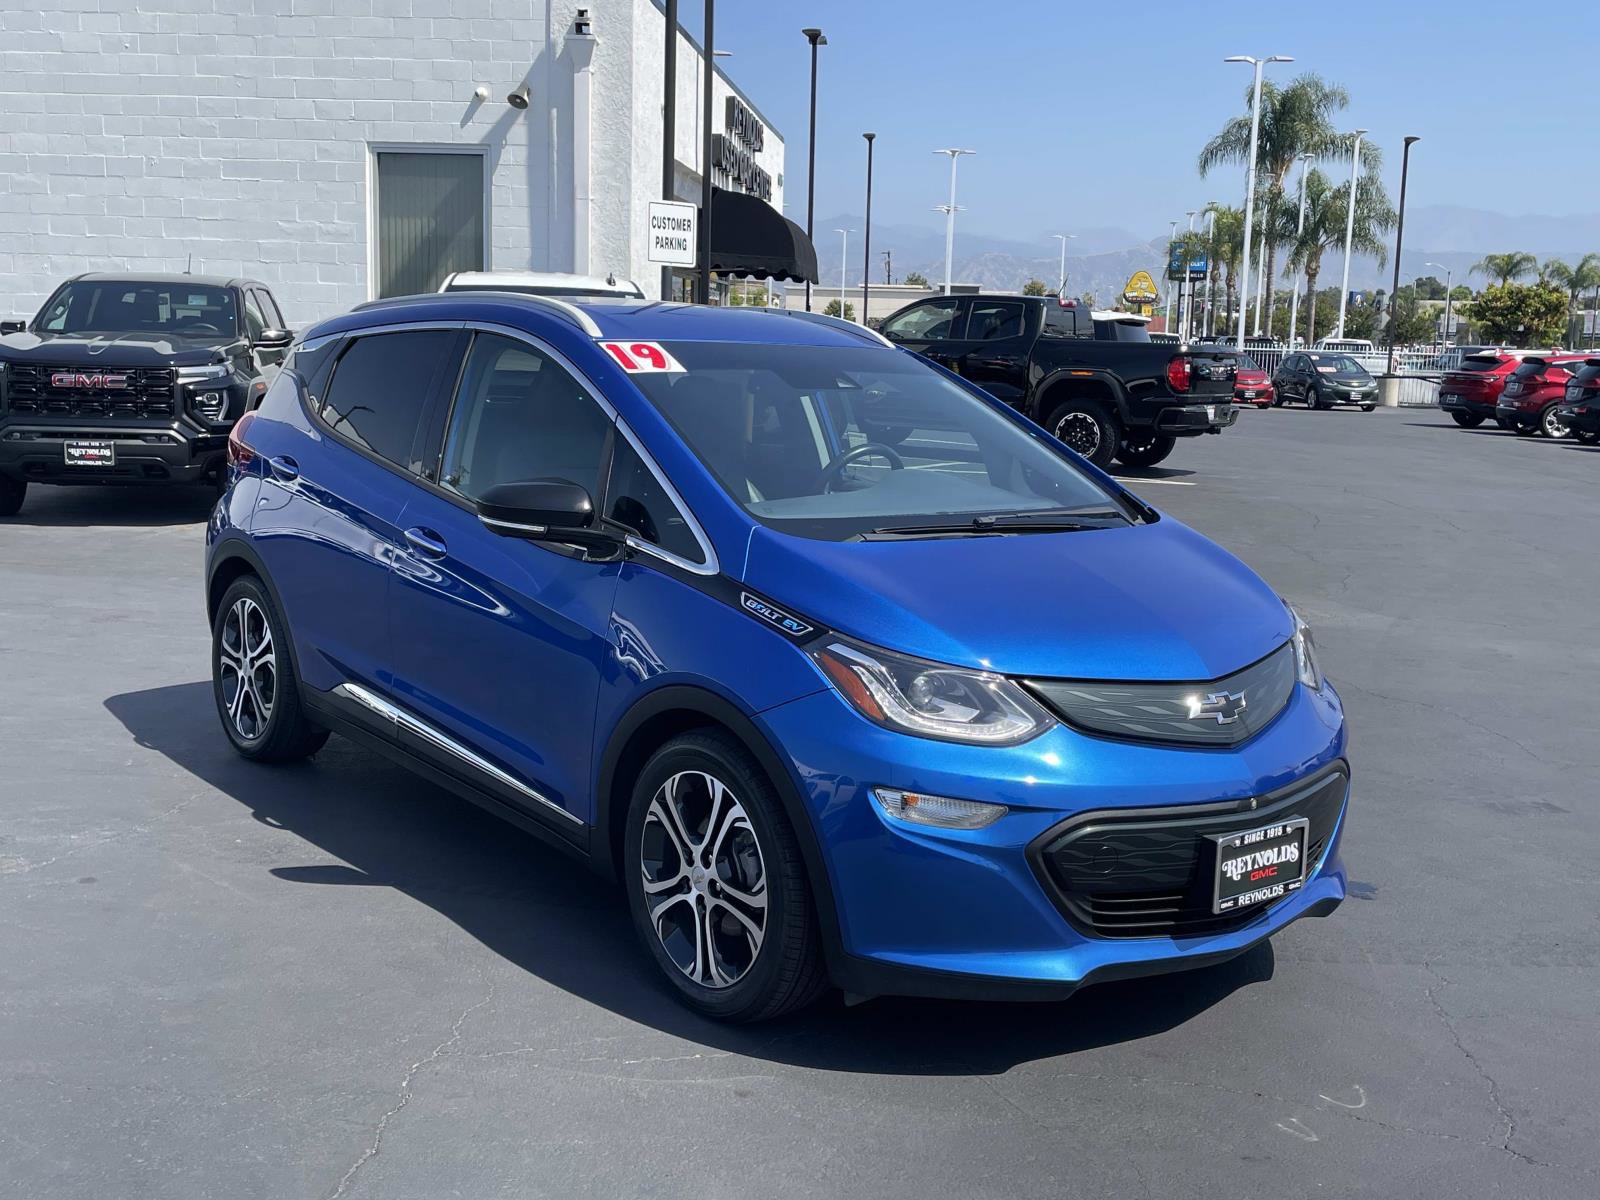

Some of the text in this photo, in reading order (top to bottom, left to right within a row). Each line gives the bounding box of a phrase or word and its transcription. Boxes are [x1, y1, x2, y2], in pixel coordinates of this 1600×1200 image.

[651, 215, 692, 232] CUSTOMER
[655, 235, 687, 251] PARKING
[605, 343, 668, 370] 19
[52, 373, 128, 389] GMC
[68, 448, 111, 457] REYNOLDS
[745, 599, 804, 631] BOLT EV
[1244, 831, 1265, 845] SINCE
[1222, 842, 1299, 881] REYNOLDS
[1250, 866, 1278, 881] GMC
[1238, 885, 1284, 906] REYNOLDS
